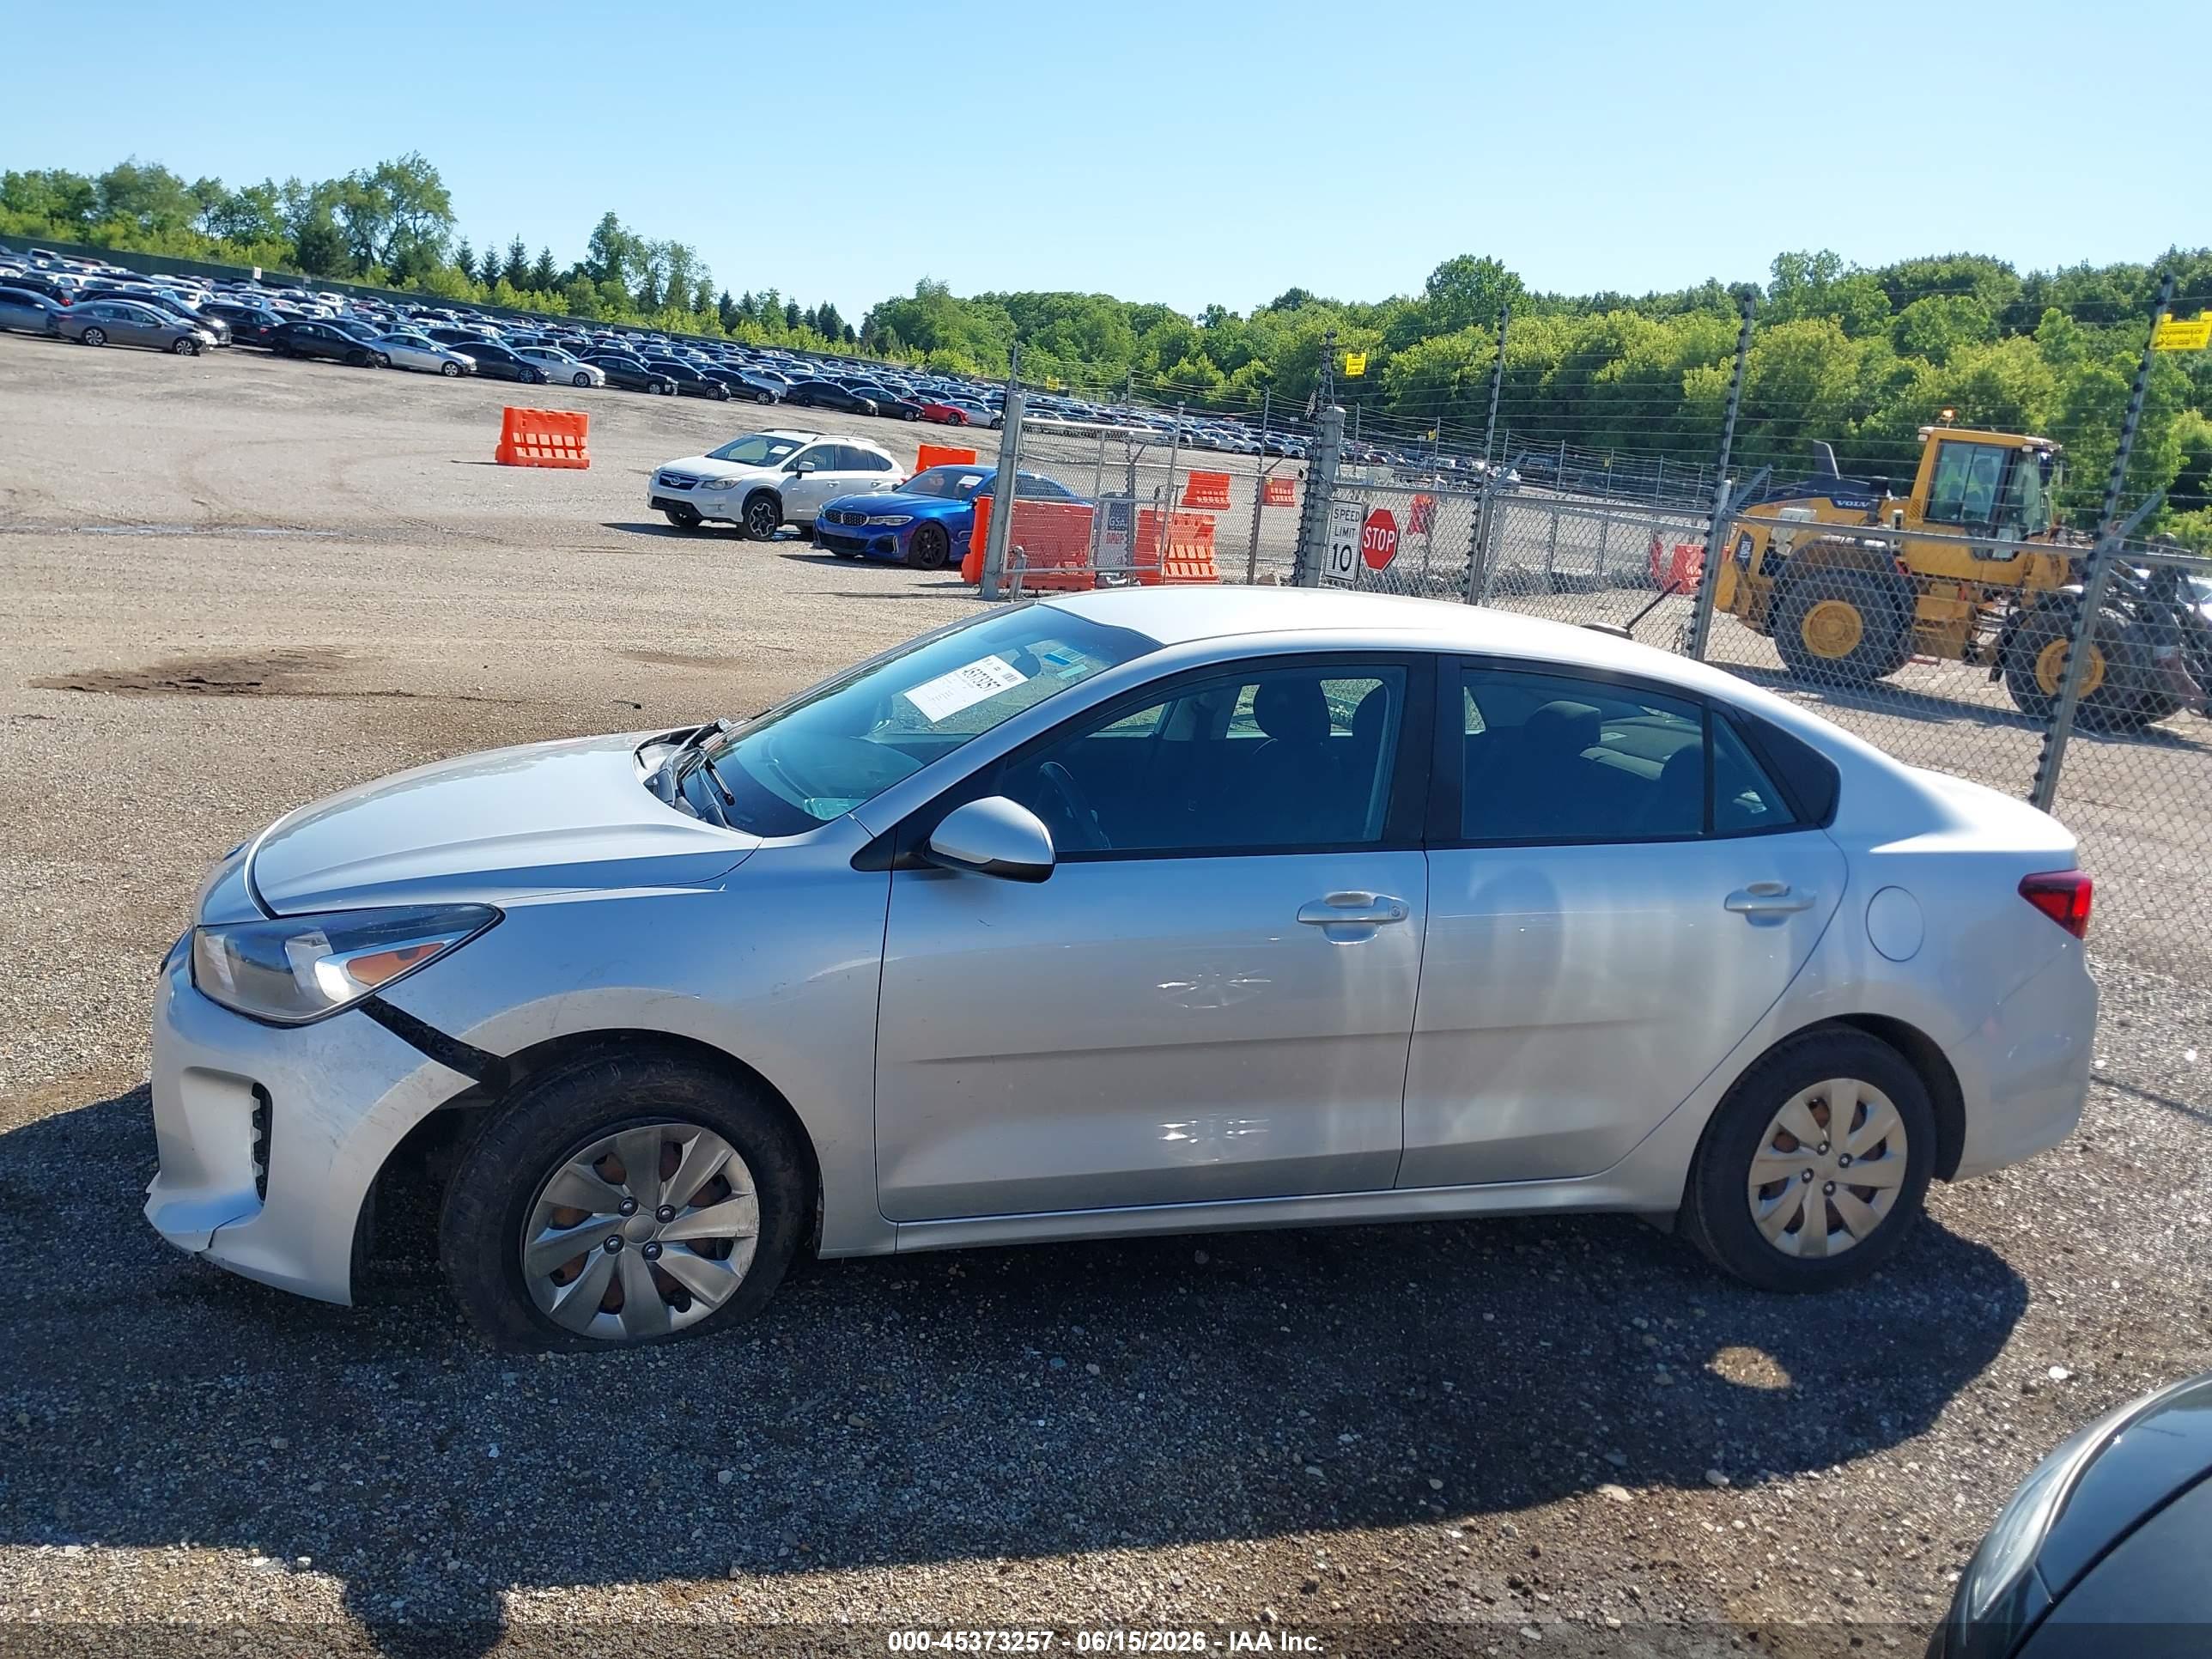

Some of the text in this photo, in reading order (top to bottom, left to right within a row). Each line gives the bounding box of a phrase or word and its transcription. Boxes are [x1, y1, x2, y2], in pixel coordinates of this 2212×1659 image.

[1334, 508, 1360, 522] SPEED
[1334, 526, 1356, 539] LIMIT
[1364, 526, 1395, 552] STOP
[1332, 543, 1352, 572] 10
